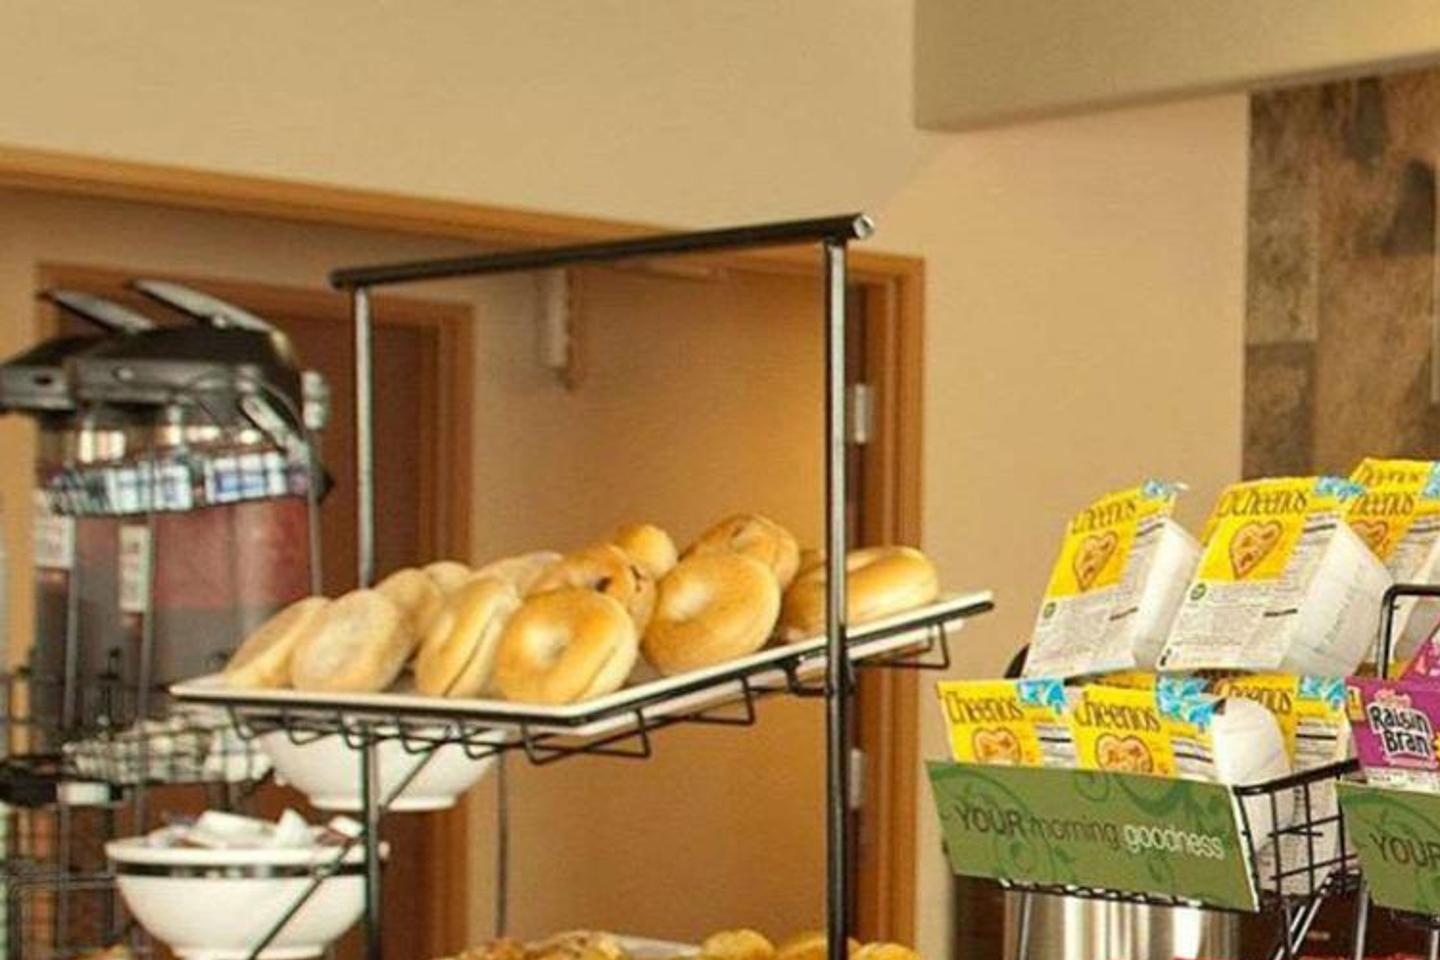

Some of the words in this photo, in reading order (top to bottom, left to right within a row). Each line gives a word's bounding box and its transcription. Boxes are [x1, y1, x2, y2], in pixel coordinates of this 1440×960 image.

[945, 690, 1025, 724] Cheerios
[1074, 694, 1161, 733] Cheerios
[1370, 705, 1428, 739] Raisin
[1383, 730, 1431, 756] Bran
[954, 803, 1029, 837] YOUR
[1030, 815, 1121, 852] morning
[1123, 823, 1226, 860] goodness
